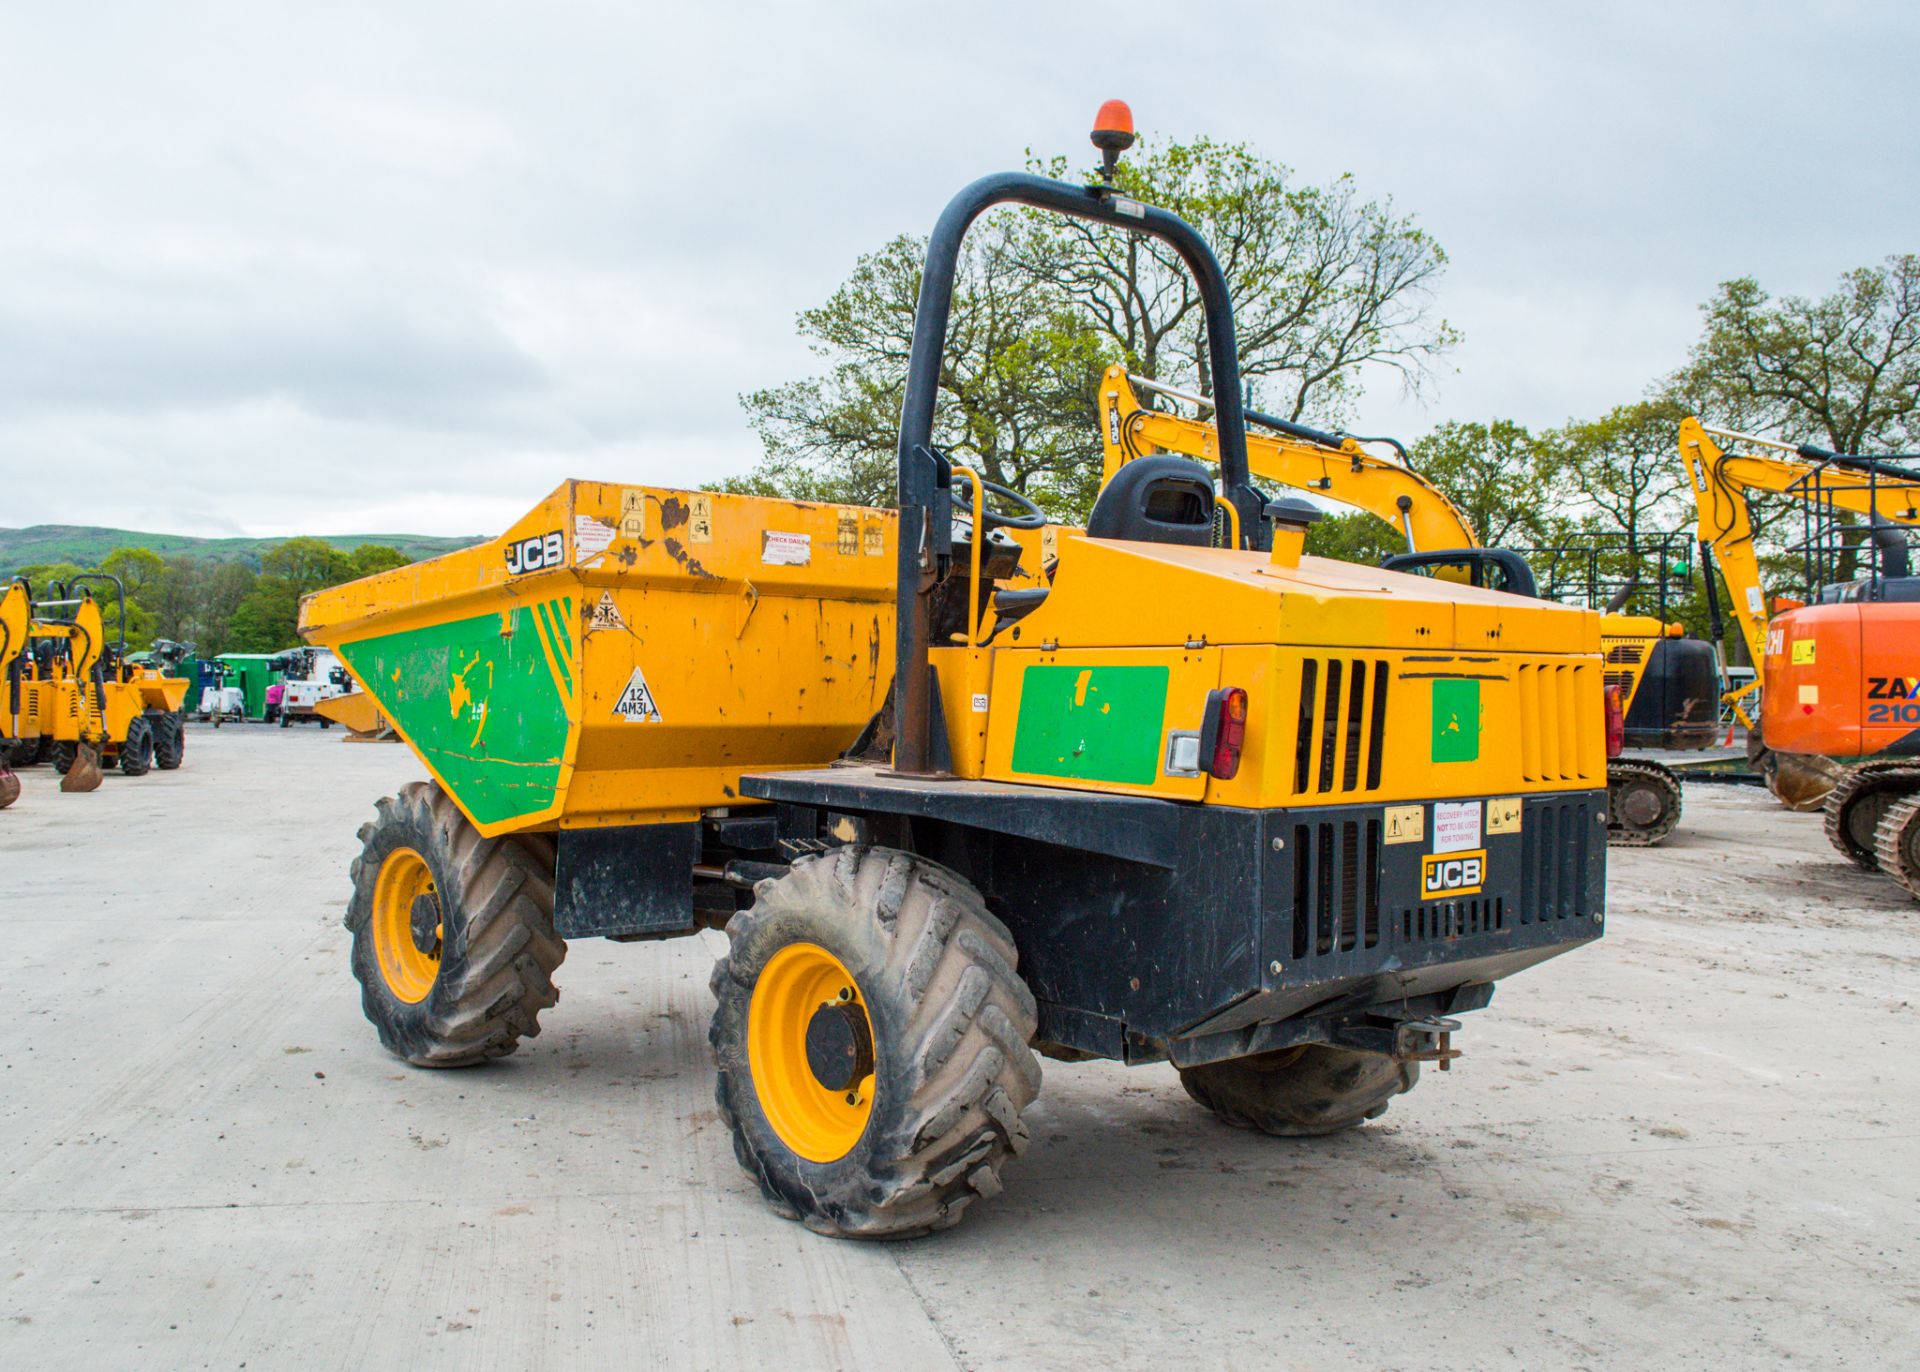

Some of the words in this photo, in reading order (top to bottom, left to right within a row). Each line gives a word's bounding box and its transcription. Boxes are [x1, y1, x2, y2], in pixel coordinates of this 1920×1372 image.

[506, 533, 563, 574] JCB
[629, 688, 644, 701] 12
[1868, 704, 1920, 722] 210
[1436, 811, 1463, 821] RECOVERY
[1463, 809, 1480, 817] HITCH
[1436, 823, 1448, 832] NOT
[1449, 822, 1457, 831] TO
[1457, 821, 1464, 830] BE
[1464, 820, 1479, 829] USED
[1441, 834, 1452, 843] FOR
[1452, 832, 1473, 841] TOWING
[1426, 859, 1481, 890] JCB
